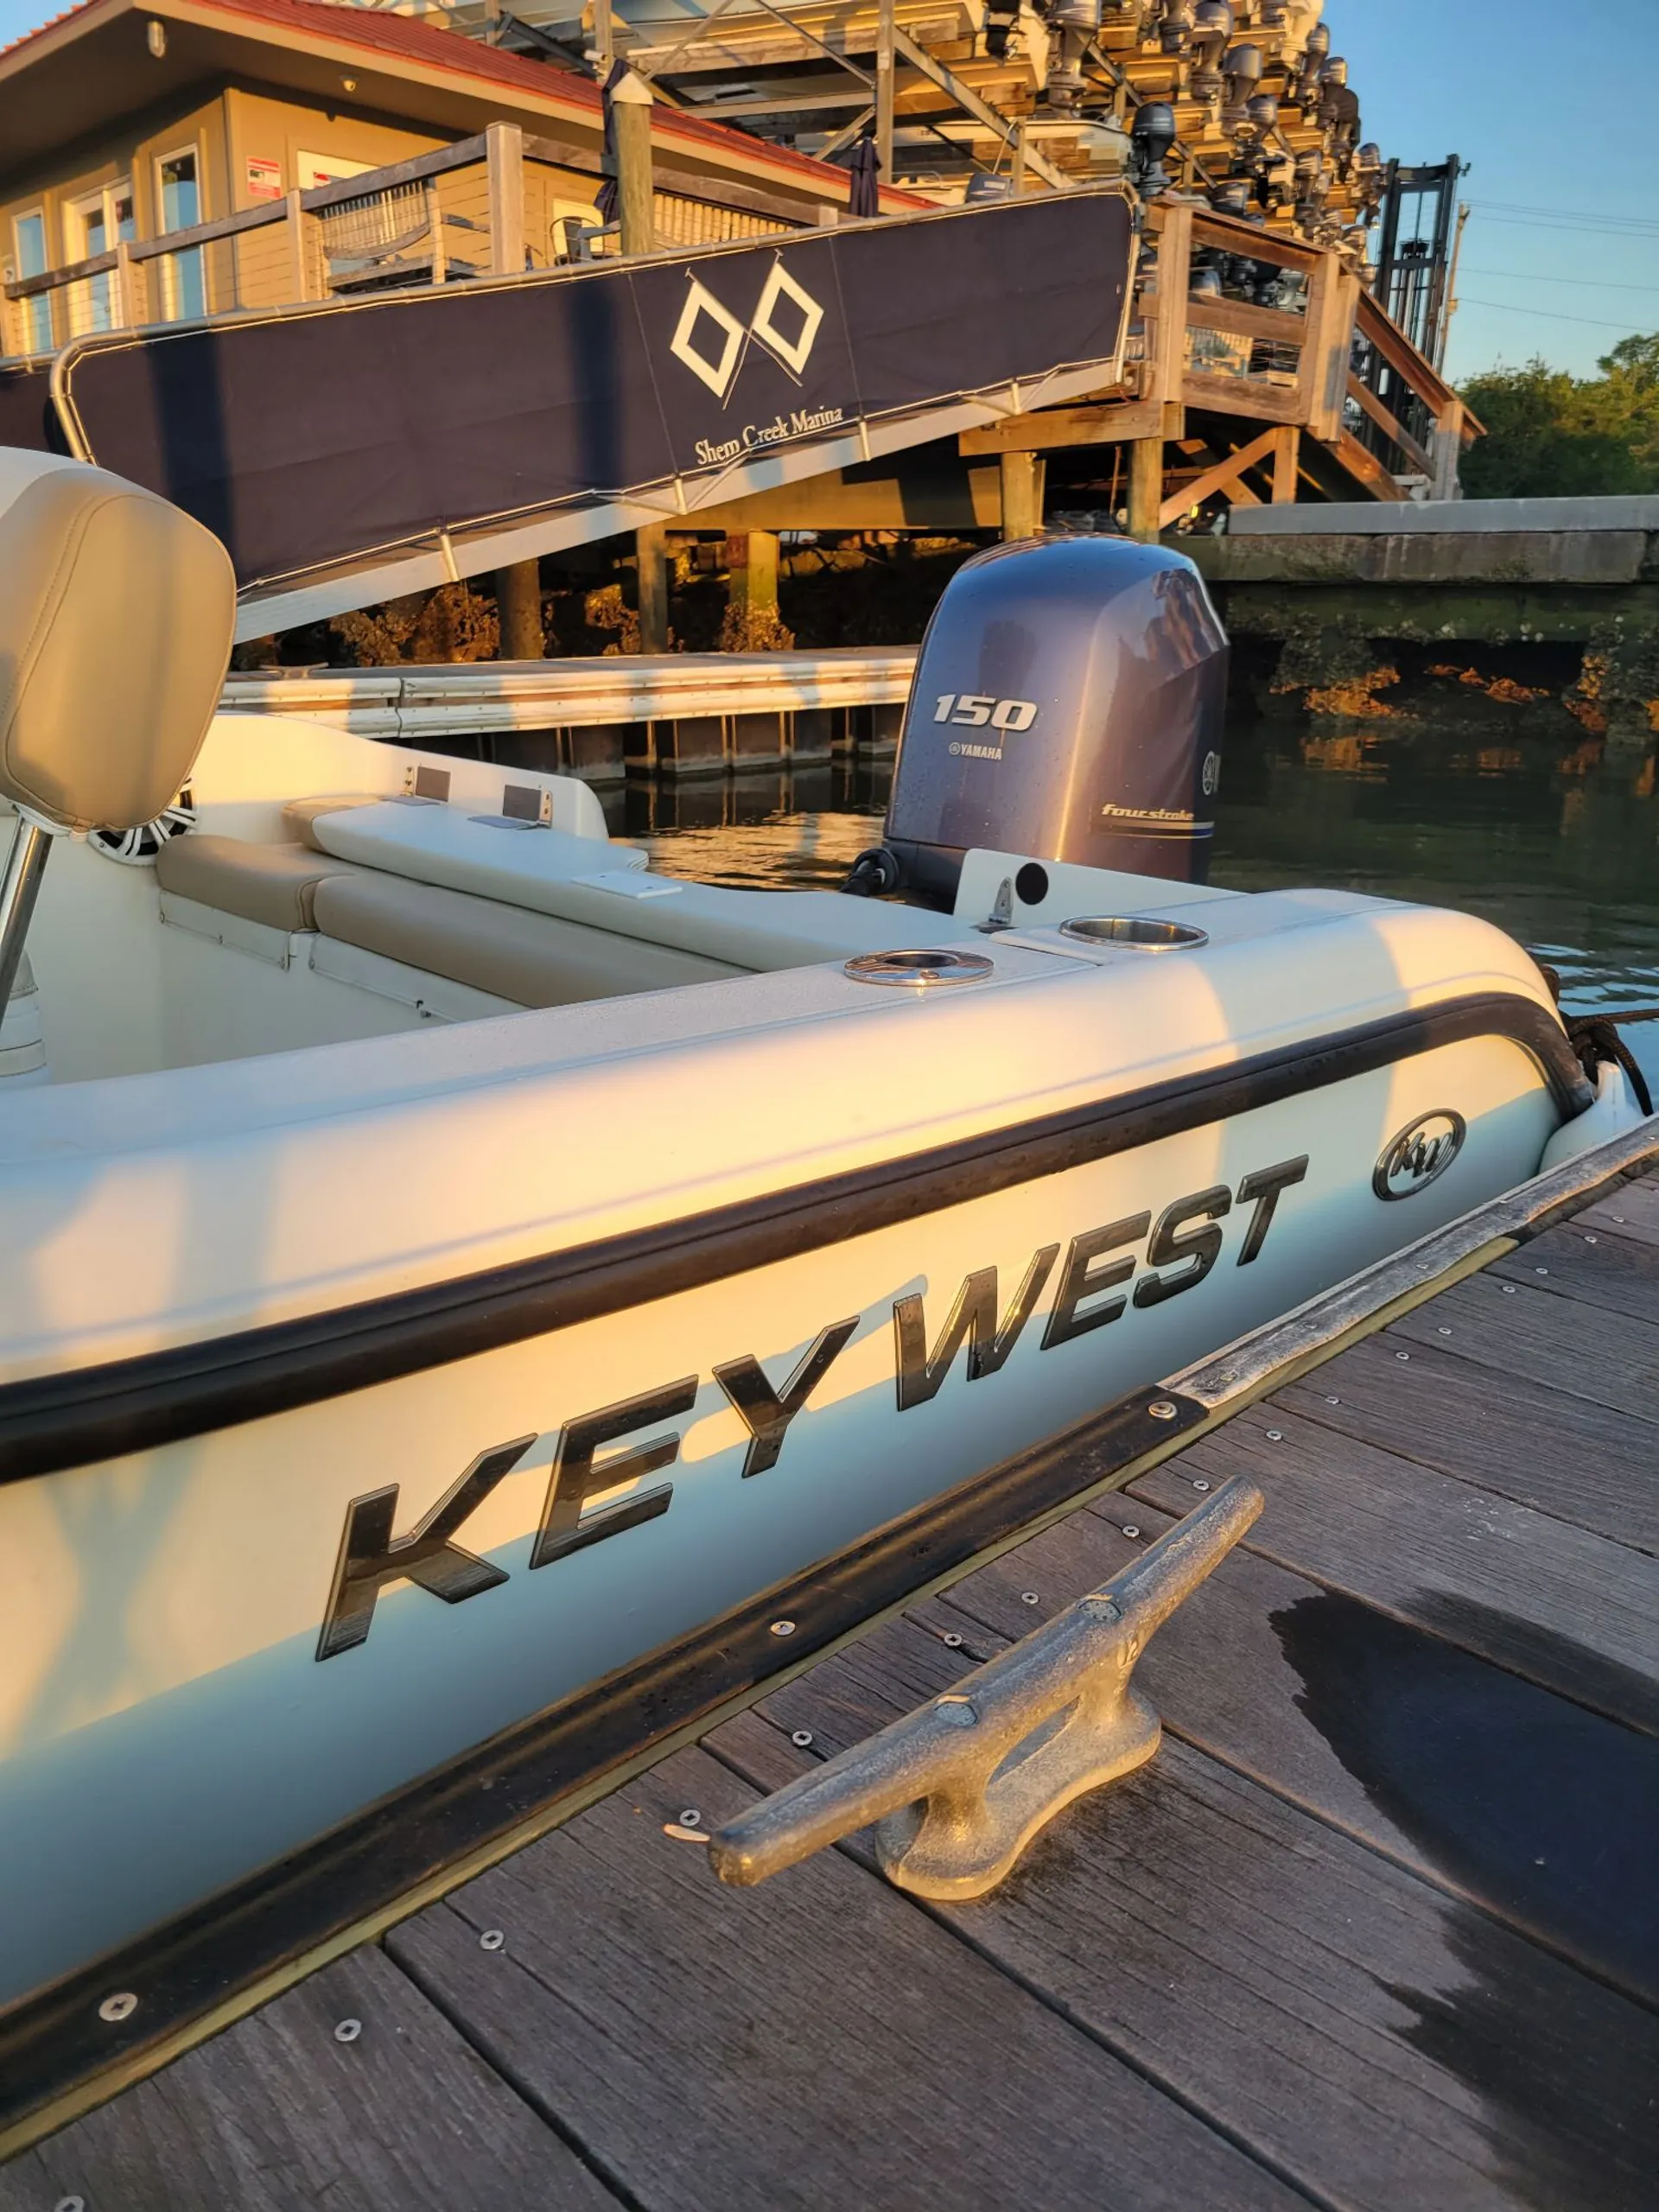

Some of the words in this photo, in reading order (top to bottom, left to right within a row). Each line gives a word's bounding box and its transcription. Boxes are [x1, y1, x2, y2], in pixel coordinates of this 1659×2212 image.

[695, 439, 740, 465] Shem
[742, 416, 790, 448] Creek
[790, 405, 844, 435] Marina
[933, 694, 1037, 731] 150
[960, 743, 1002, 760] YAMAHA
[315, 1314, 861, 1662] KEY
[893, 1154, 1310, 1413] WEST
